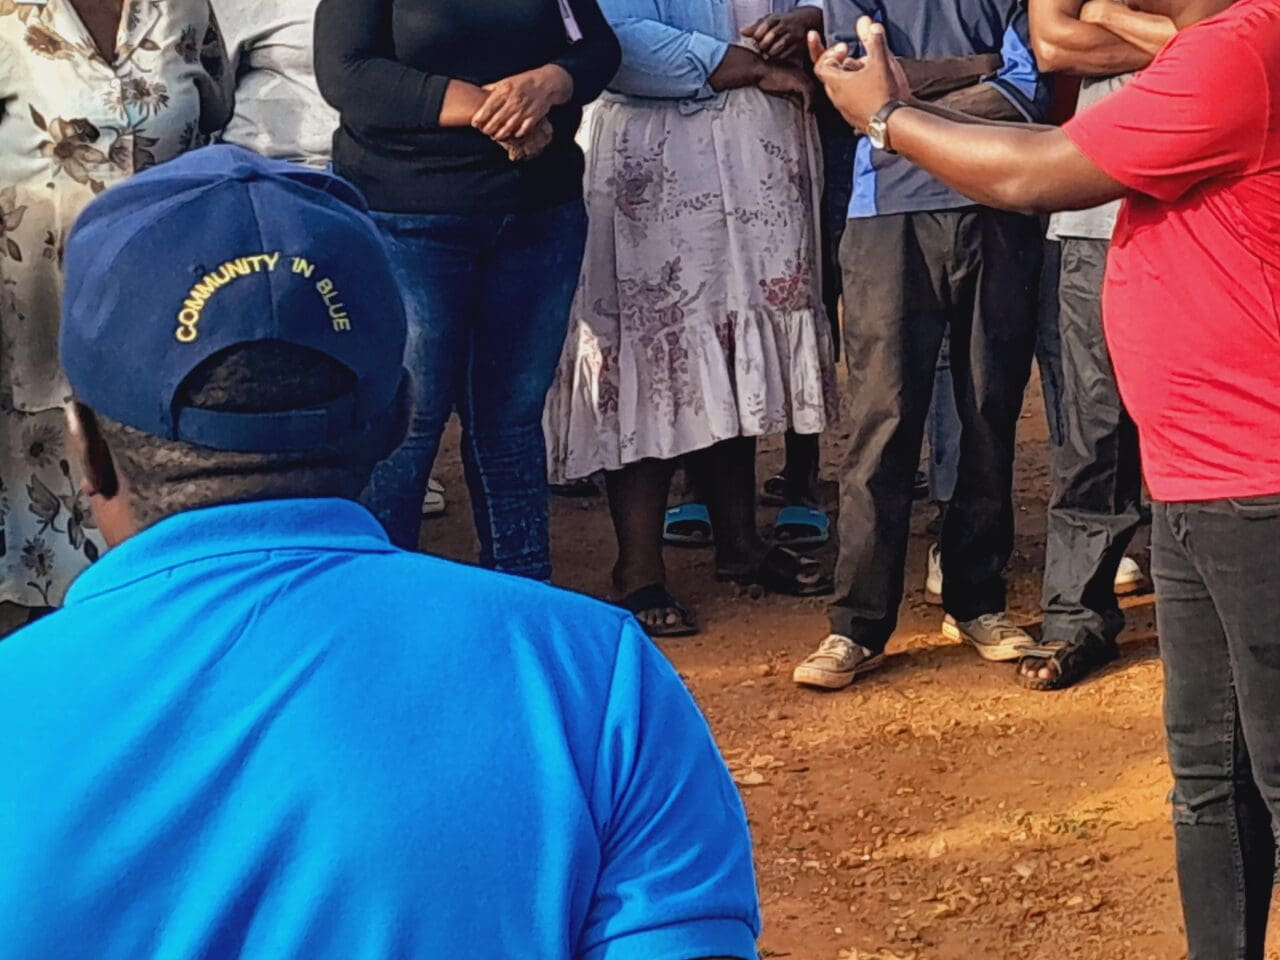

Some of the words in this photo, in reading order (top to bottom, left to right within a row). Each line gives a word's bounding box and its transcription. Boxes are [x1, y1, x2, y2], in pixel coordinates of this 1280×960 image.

[175, 251, 281, 343] COMMUNITY
[290, 256, 316, 279] IN
[315, 277, 352, 333] BLUE
